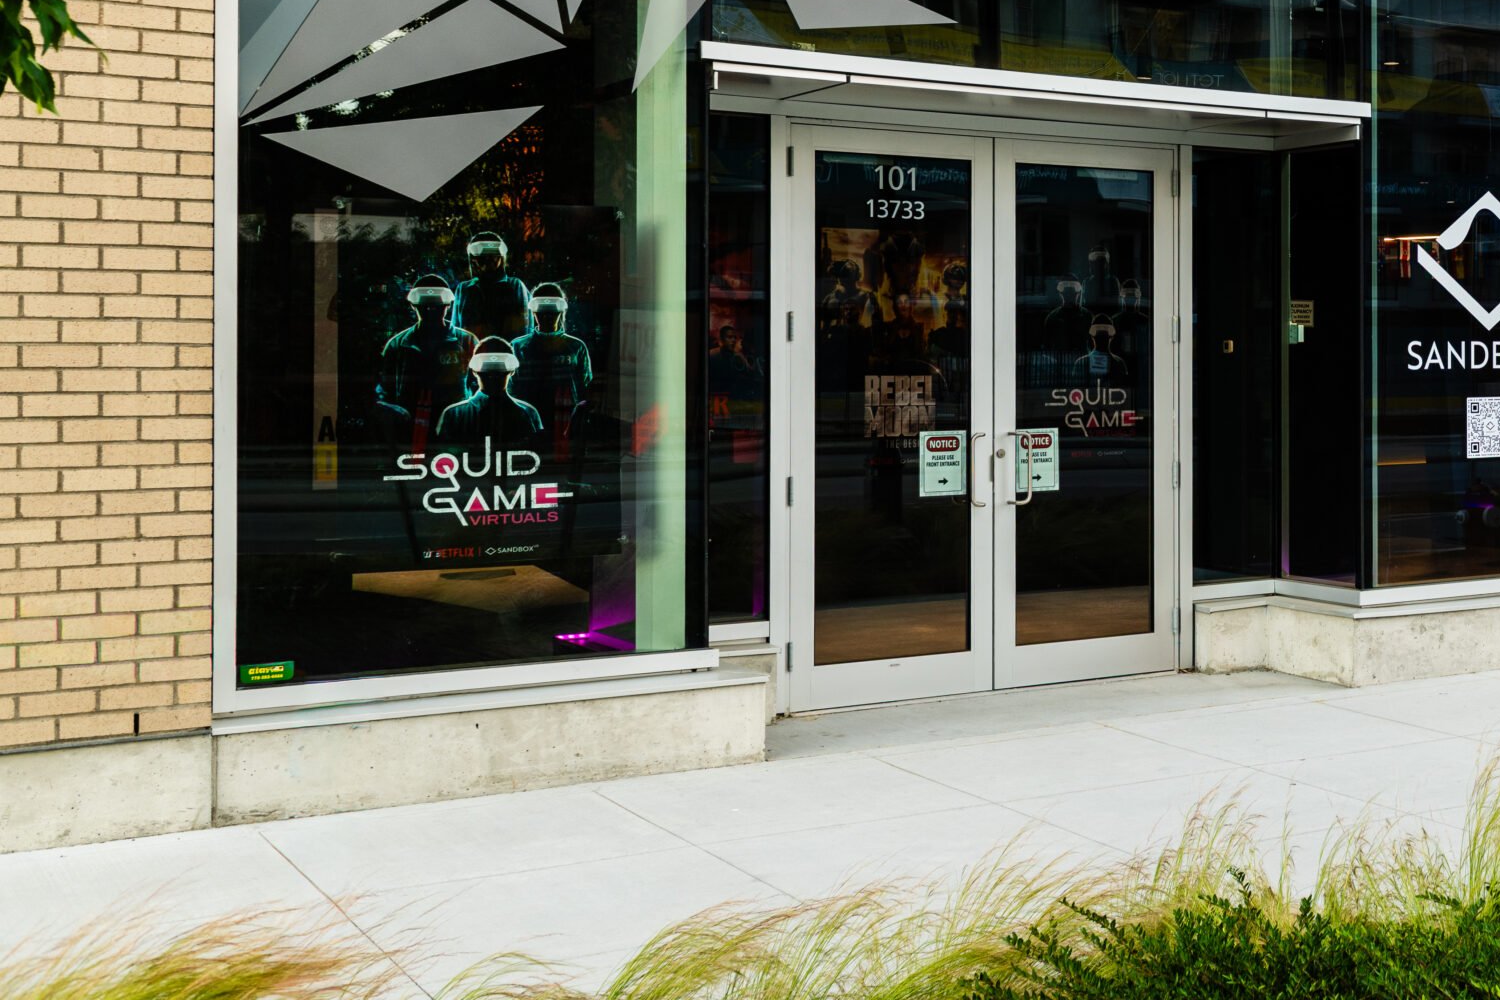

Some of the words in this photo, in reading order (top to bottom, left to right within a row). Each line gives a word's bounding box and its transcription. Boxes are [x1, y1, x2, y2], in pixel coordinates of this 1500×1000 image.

[874, 165, 917, 191] 101
[866, 199, 925, 220] 13733
[864, 375, 936, 406] REBEL
[1045, 378, 1127, 411] SQUID
[1065, 410, 1144, 437] GAME
[903, 439, 920, 449] BES
[929, 440, 957, 449] NOTICE
[383, 436, 541, 489] SQUID
[422, 482, 574, 526] GAME
[469, 511, 559, 526] VIRTUALS
